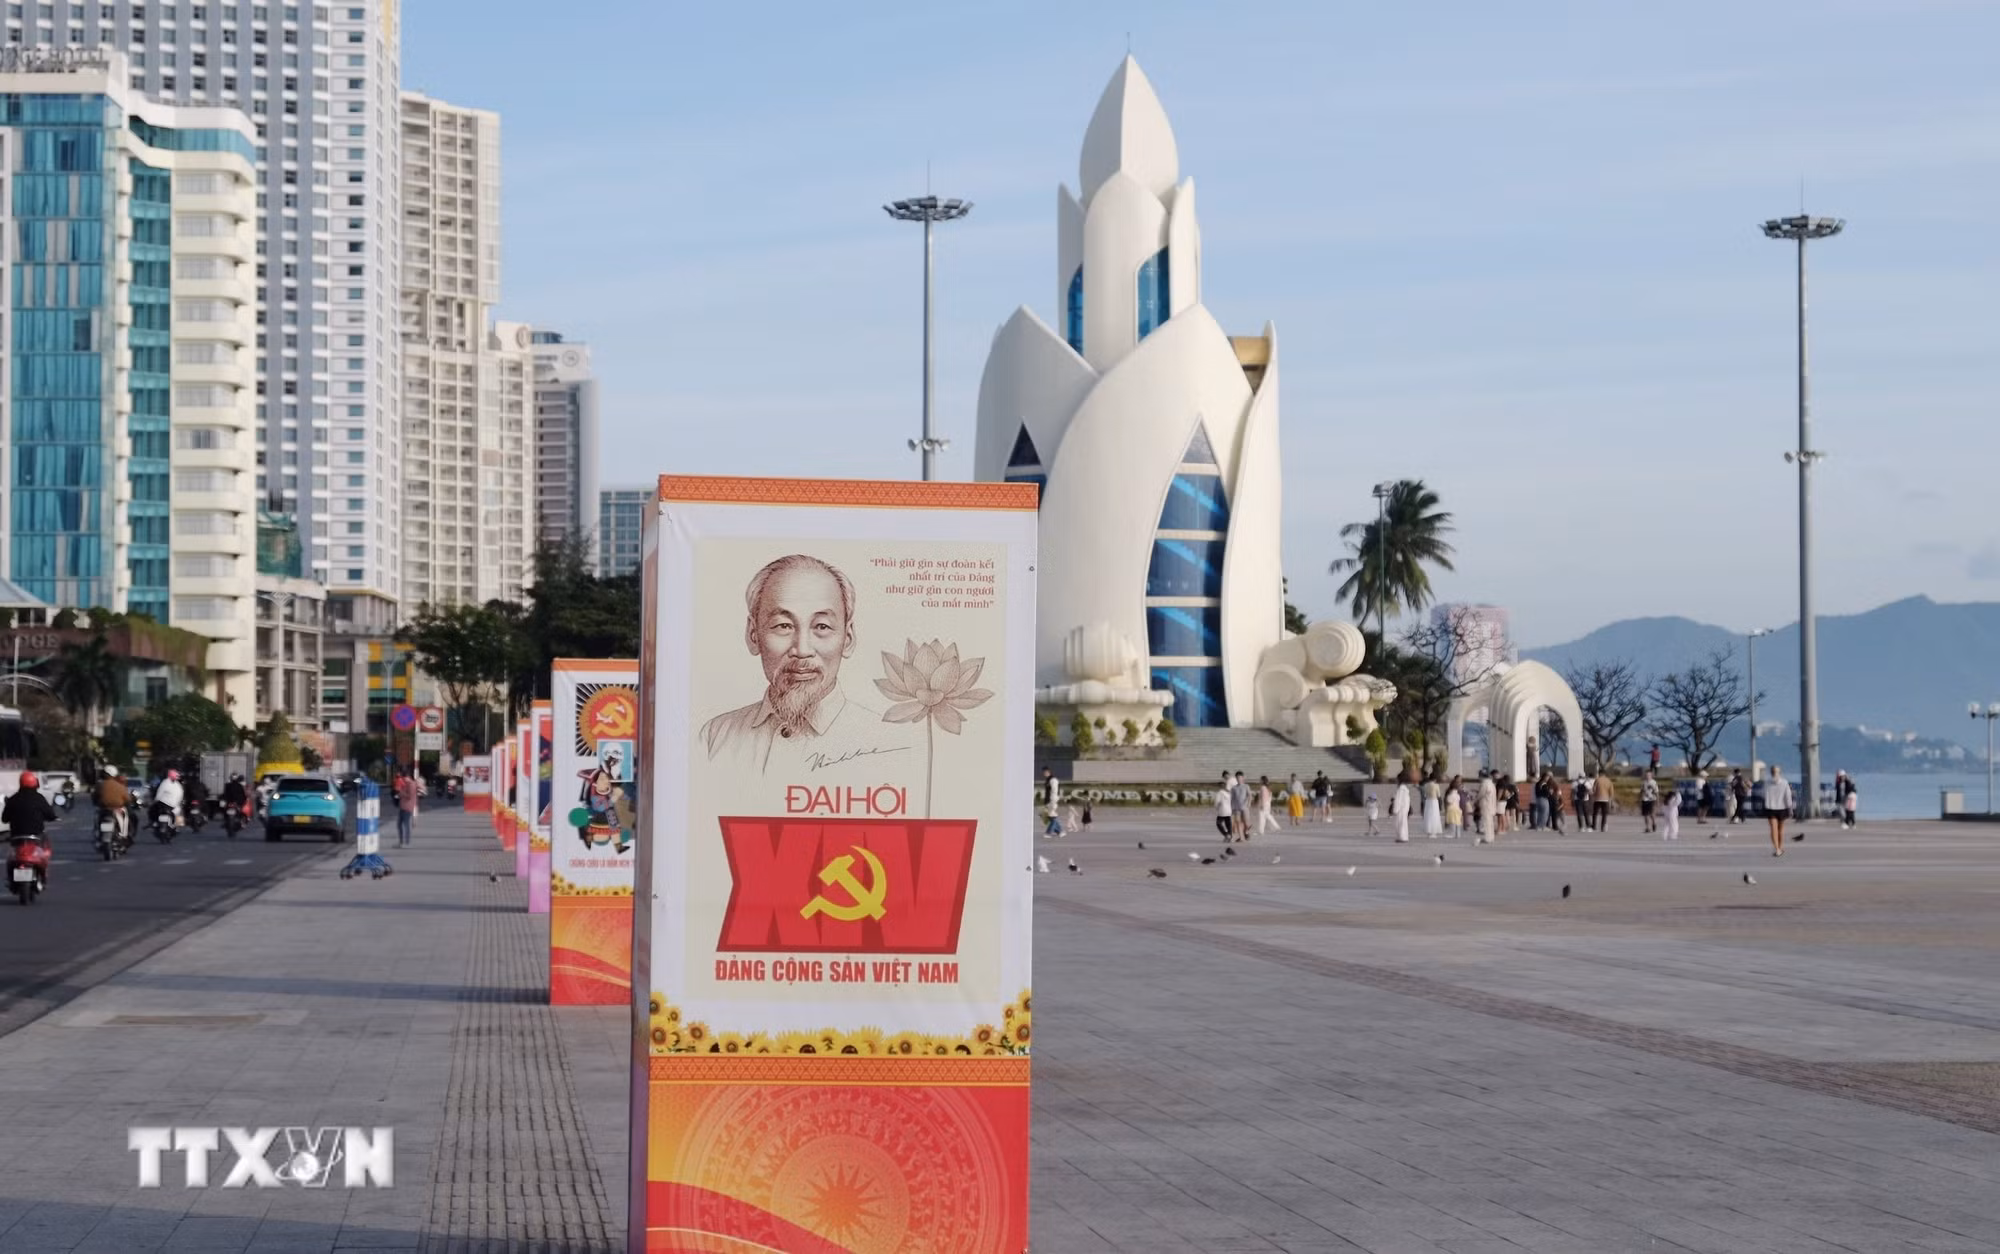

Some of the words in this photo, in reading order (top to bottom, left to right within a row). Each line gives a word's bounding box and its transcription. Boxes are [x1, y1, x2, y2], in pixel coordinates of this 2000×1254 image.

[944, 587, 963, 595] con
[785, 785, 841, 816] ĐẠI
[846, 783, 907, 817] HỘI
[1145, 789, 1178, 802] TO
[715, 955, 766, 981] ĐẢNG
[772, 957, 823, 985] CỘNG
[829, 956, 866, 982] SẢN
[872, 958, 912, 987] VIỆT
[917, 962, 959, 983] NAM
